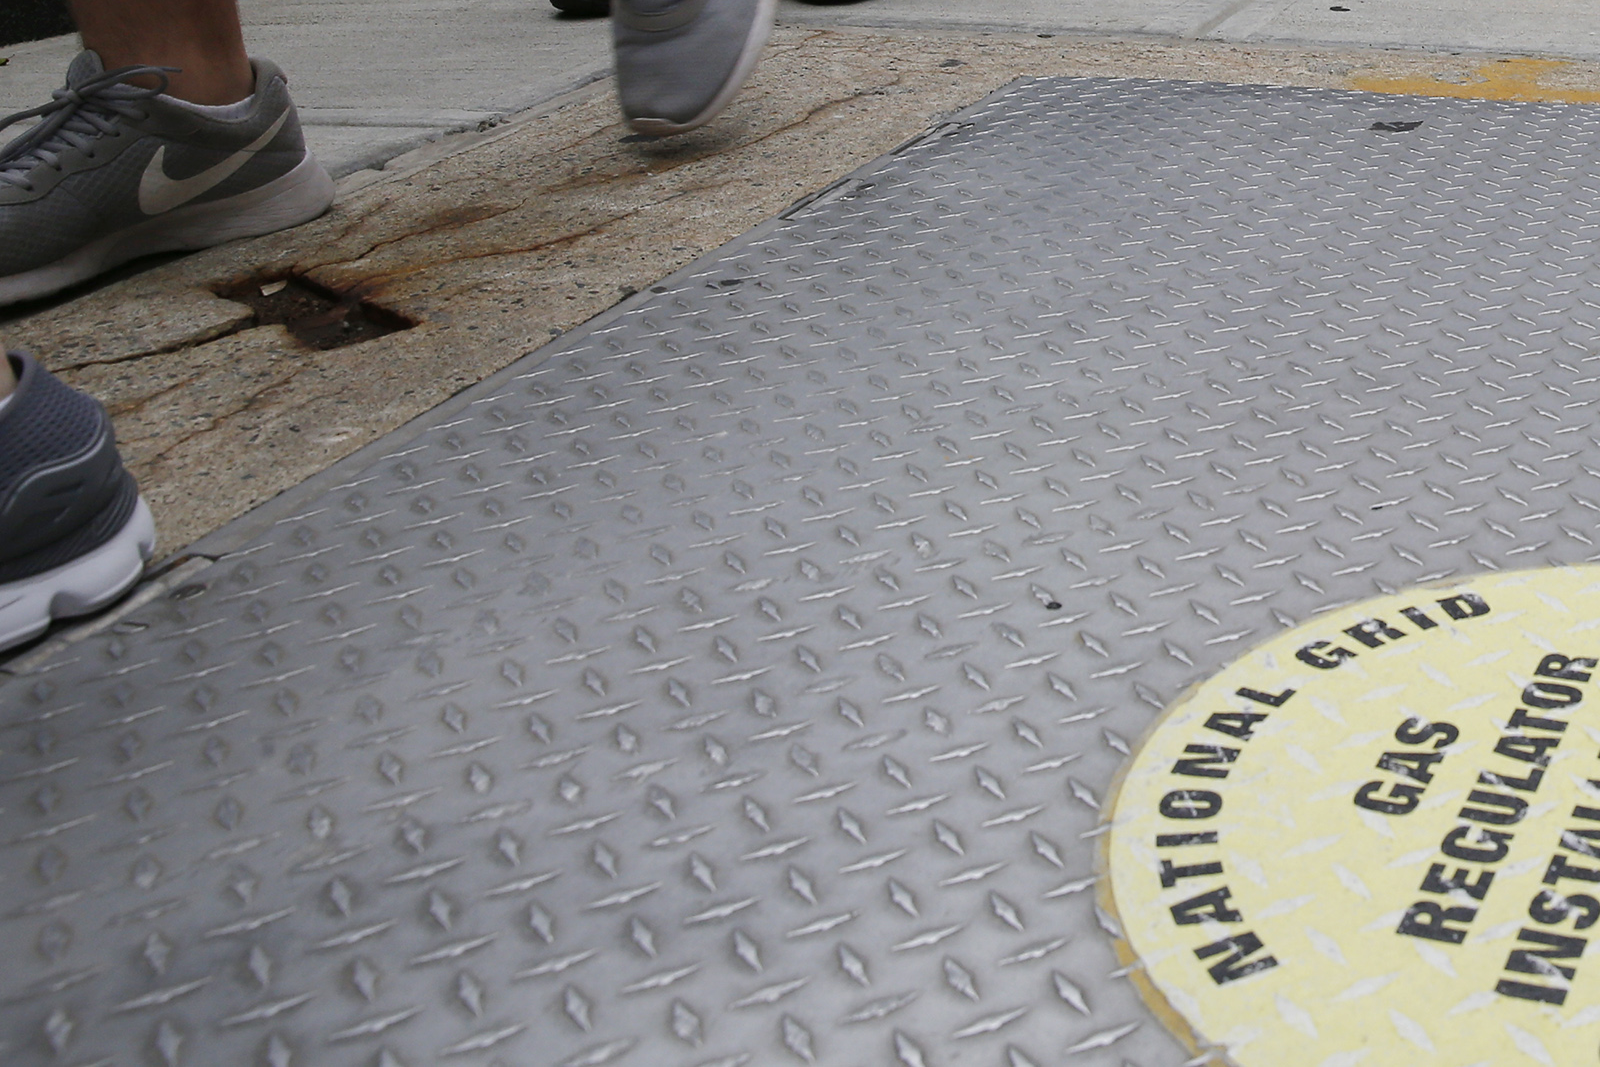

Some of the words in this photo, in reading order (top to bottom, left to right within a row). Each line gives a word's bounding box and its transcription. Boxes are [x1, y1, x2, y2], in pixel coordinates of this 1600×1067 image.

[1155, 687, 1297, 985] NATIONAL
[1294, 592, 1491, 670] GRID
[1353, 716, 1460, 816] GAS
[1396, 653, 1600, 945] REGULATOR
